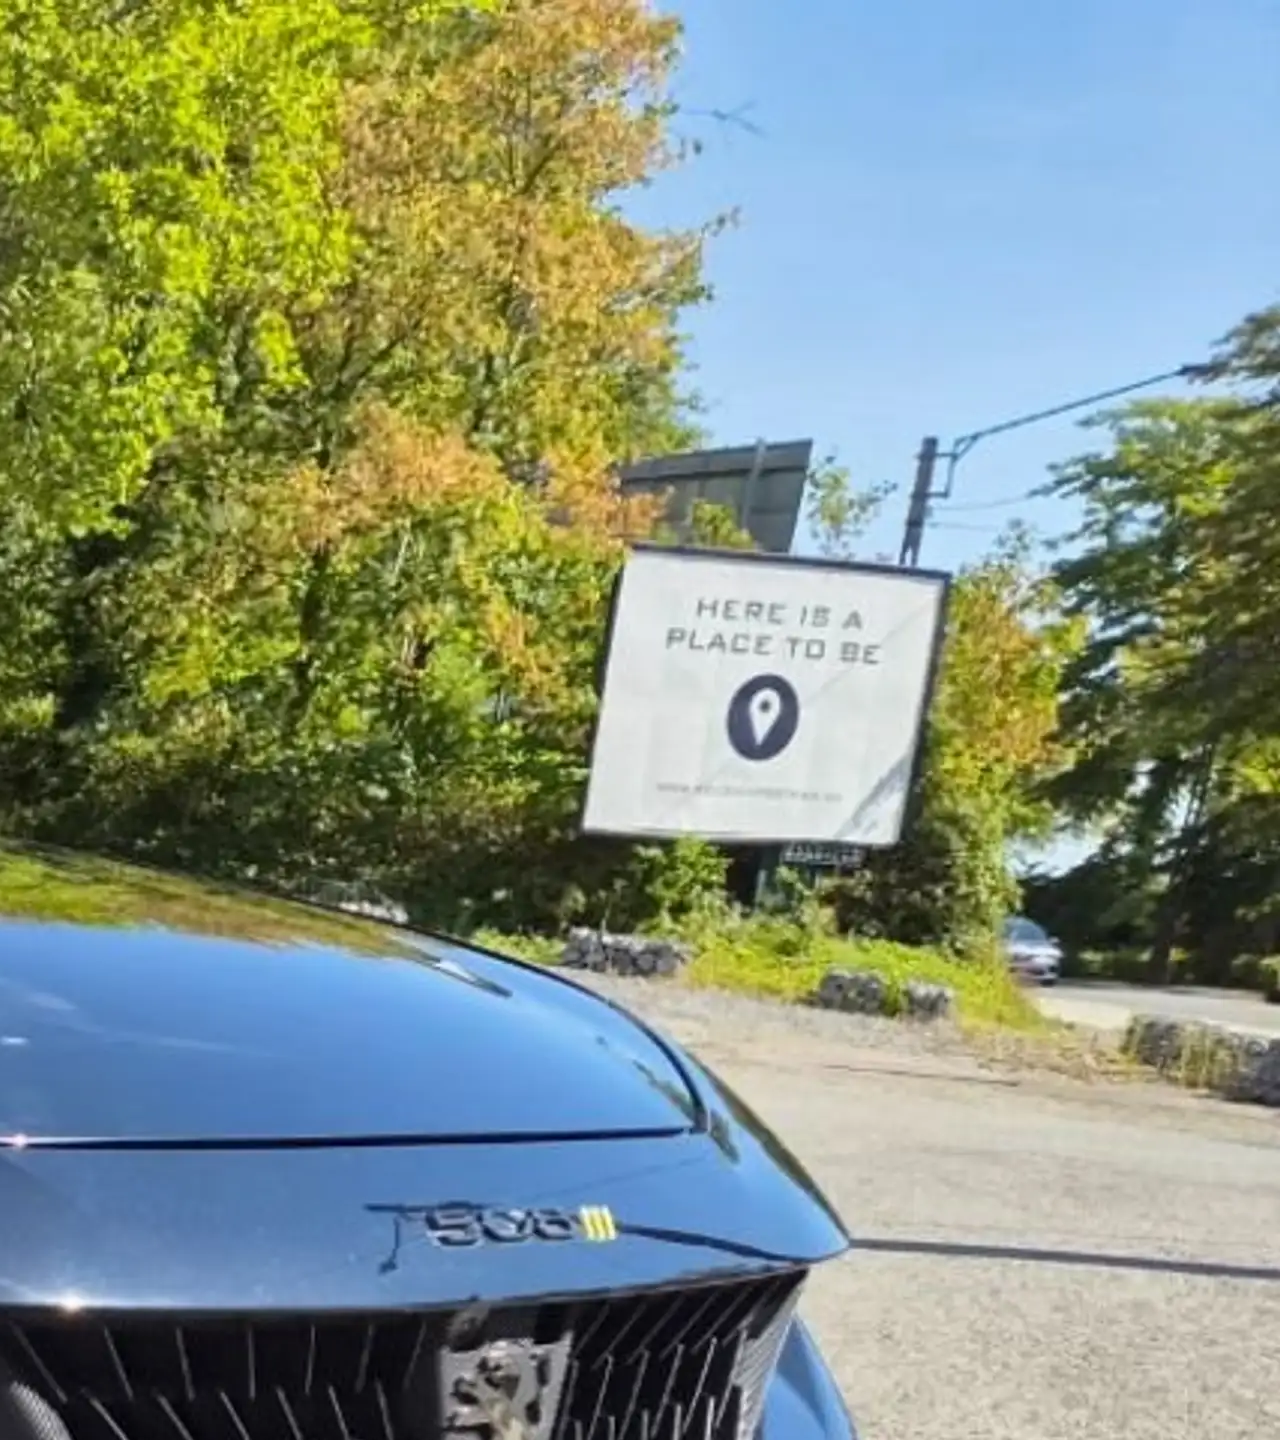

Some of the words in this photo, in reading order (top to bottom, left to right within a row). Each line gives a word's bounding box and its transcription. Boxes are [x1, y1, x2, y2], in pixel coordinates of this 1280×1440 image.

[696, 598, 787, 625] HERE
[800, 605, 832, 629] IS
[842, 609, 863, 630] A
[666, 626, 774, 656] PLACE
[786, 635, 827, 659] TO
[839, 640, 882, 665] BE
